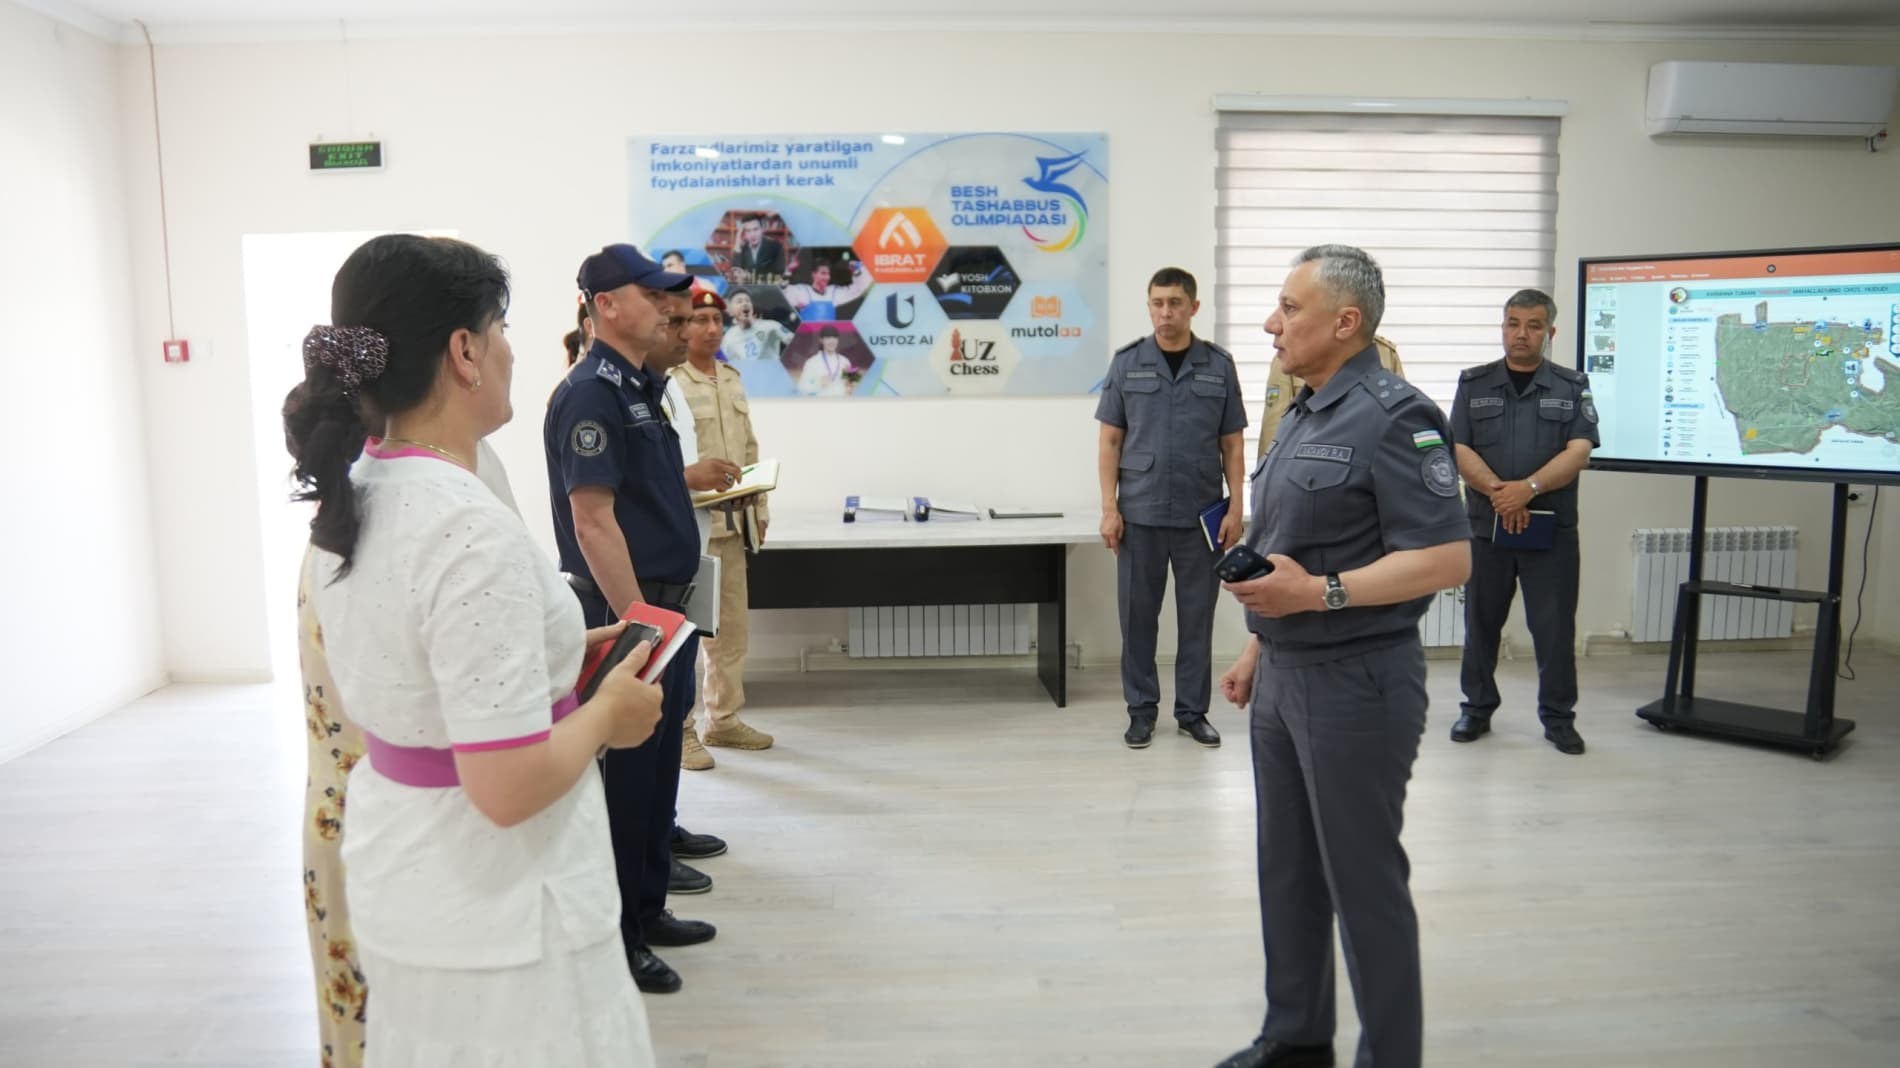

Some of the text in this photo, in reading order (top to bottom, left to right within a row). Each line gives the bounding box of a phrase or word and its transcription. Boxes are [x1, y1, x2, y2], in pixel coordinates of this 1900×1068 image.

[650, 140, 873, 156] Farzadlarimiz yaratilgan
[650, 156, 858, 173] imkoniyatlardan unumli
[651, 174, 834, 190] foydalanishlari kerak
[951, 186, 998, 197] BESH
[952, 200, 1060, 211] TASHABBUS
[951, 214, 1066, 225] OLIMPIADASI
[874, 254, 926, 265] IBRAT
[961, 273, 988, 281] YOSH
[961, 285, 1012, 293] KITOBXON
[1011, 324, 1082, 338] mutolaa
[869, 335, 933, 345] USTOZ AI
[961, 339, 996, 361] UZ
[950, 363, 999, 376] Chess
